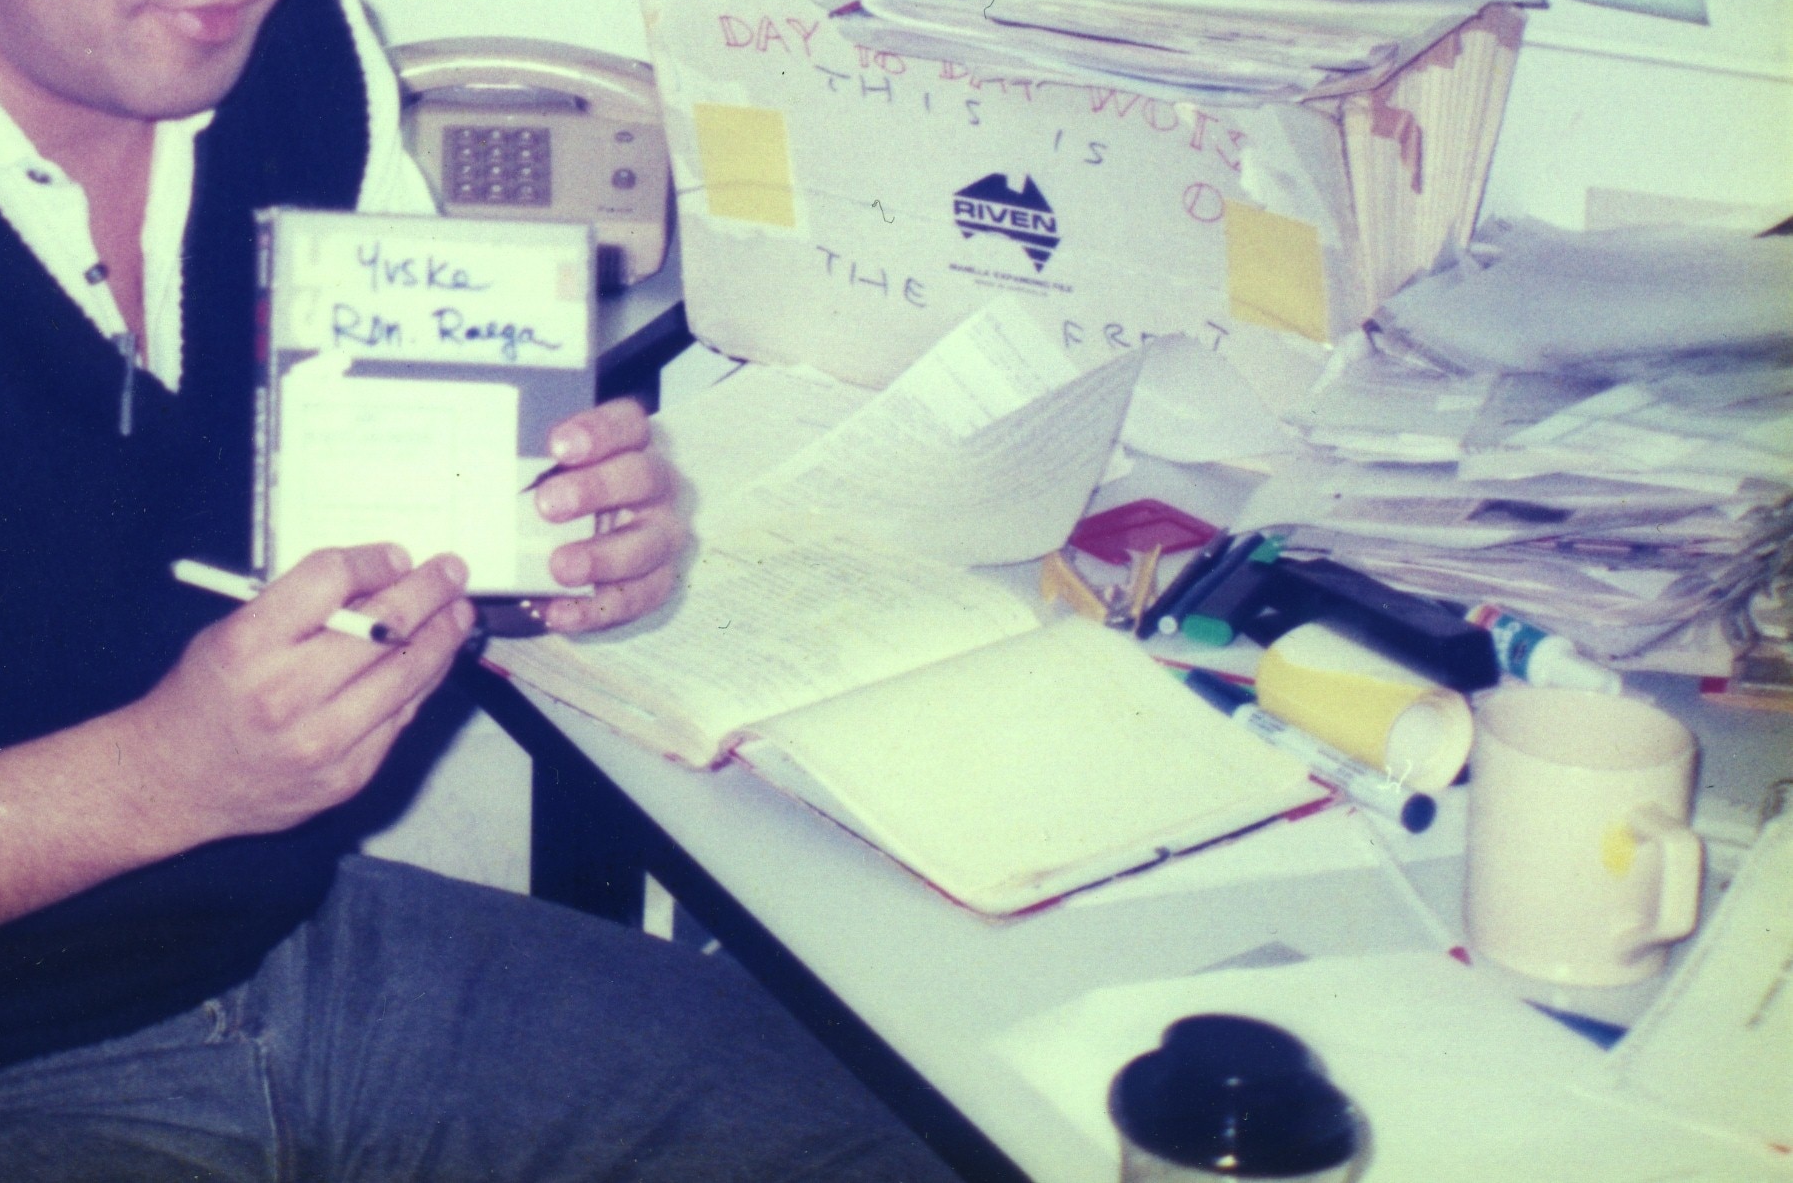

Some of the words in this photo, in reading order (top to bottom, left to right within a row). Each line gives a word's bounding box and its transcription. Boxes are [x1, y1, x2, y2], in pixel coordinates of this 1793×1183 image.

[718, 13, 821, 58] DAY
[814, 64, 982, 126] THIS
[1052, 128, 1109, 166] IS
[952, 198, 1057, 233] RIVEN
[815, 245, 928, 308] THE
[1062, 319, 1230, 353] FRT
